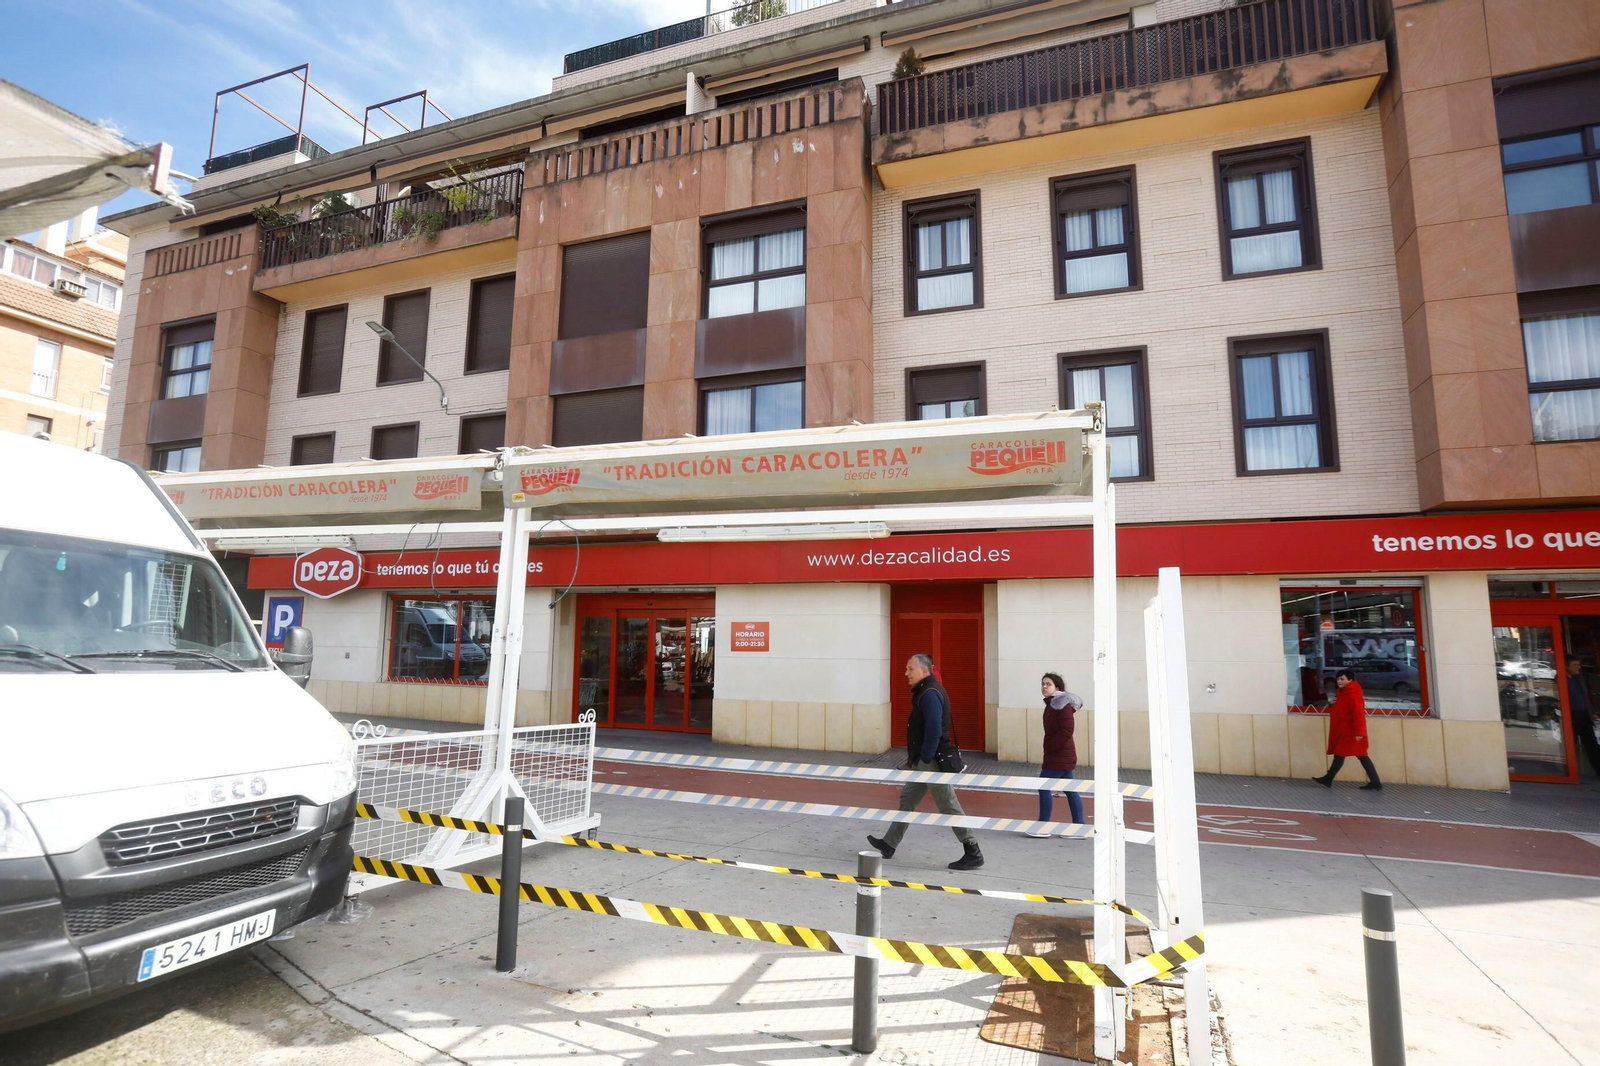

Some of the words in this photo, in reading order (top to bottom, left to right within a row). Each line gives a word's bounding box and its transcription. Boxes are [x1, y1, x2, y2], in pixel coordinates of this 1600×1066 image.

[971, 438, 1045, 449] CARACOLES
[520, 466, 568, 476] CARACOLES
[603, 455, 731, 481] "TRADICIÓN
[741, 446, 922, 474] CARACOLERA"
[1026, 466, 1054, 475] RAFA
[844, 470, 876, 481] desde
[881, 467, 909, 479] 1974
[201, 482, 283, 500] "TRADICIÓN
[288, 478, 396, 497] CARACOLERA"
[348, 495, 369, 503] desde
[371, 493, 388, 502] 1974
[1371, 534, 1497, 553] tenemos
[1505, 529, 1535, 549] lo
[1543, 530, 1600, 552] que
[807, 545, 1011, 567] www.dezacalidad.es
[377, 563, 429, 576] tenemos
[432, 561, 444, 575] lo
[447, 563, 472, 577] que
[475, 559, 489, 574] tú
[274, 604, 294, 637] P
[162, 931, 221, 969] 5241
[230, 914, 271, 947] HMJ
